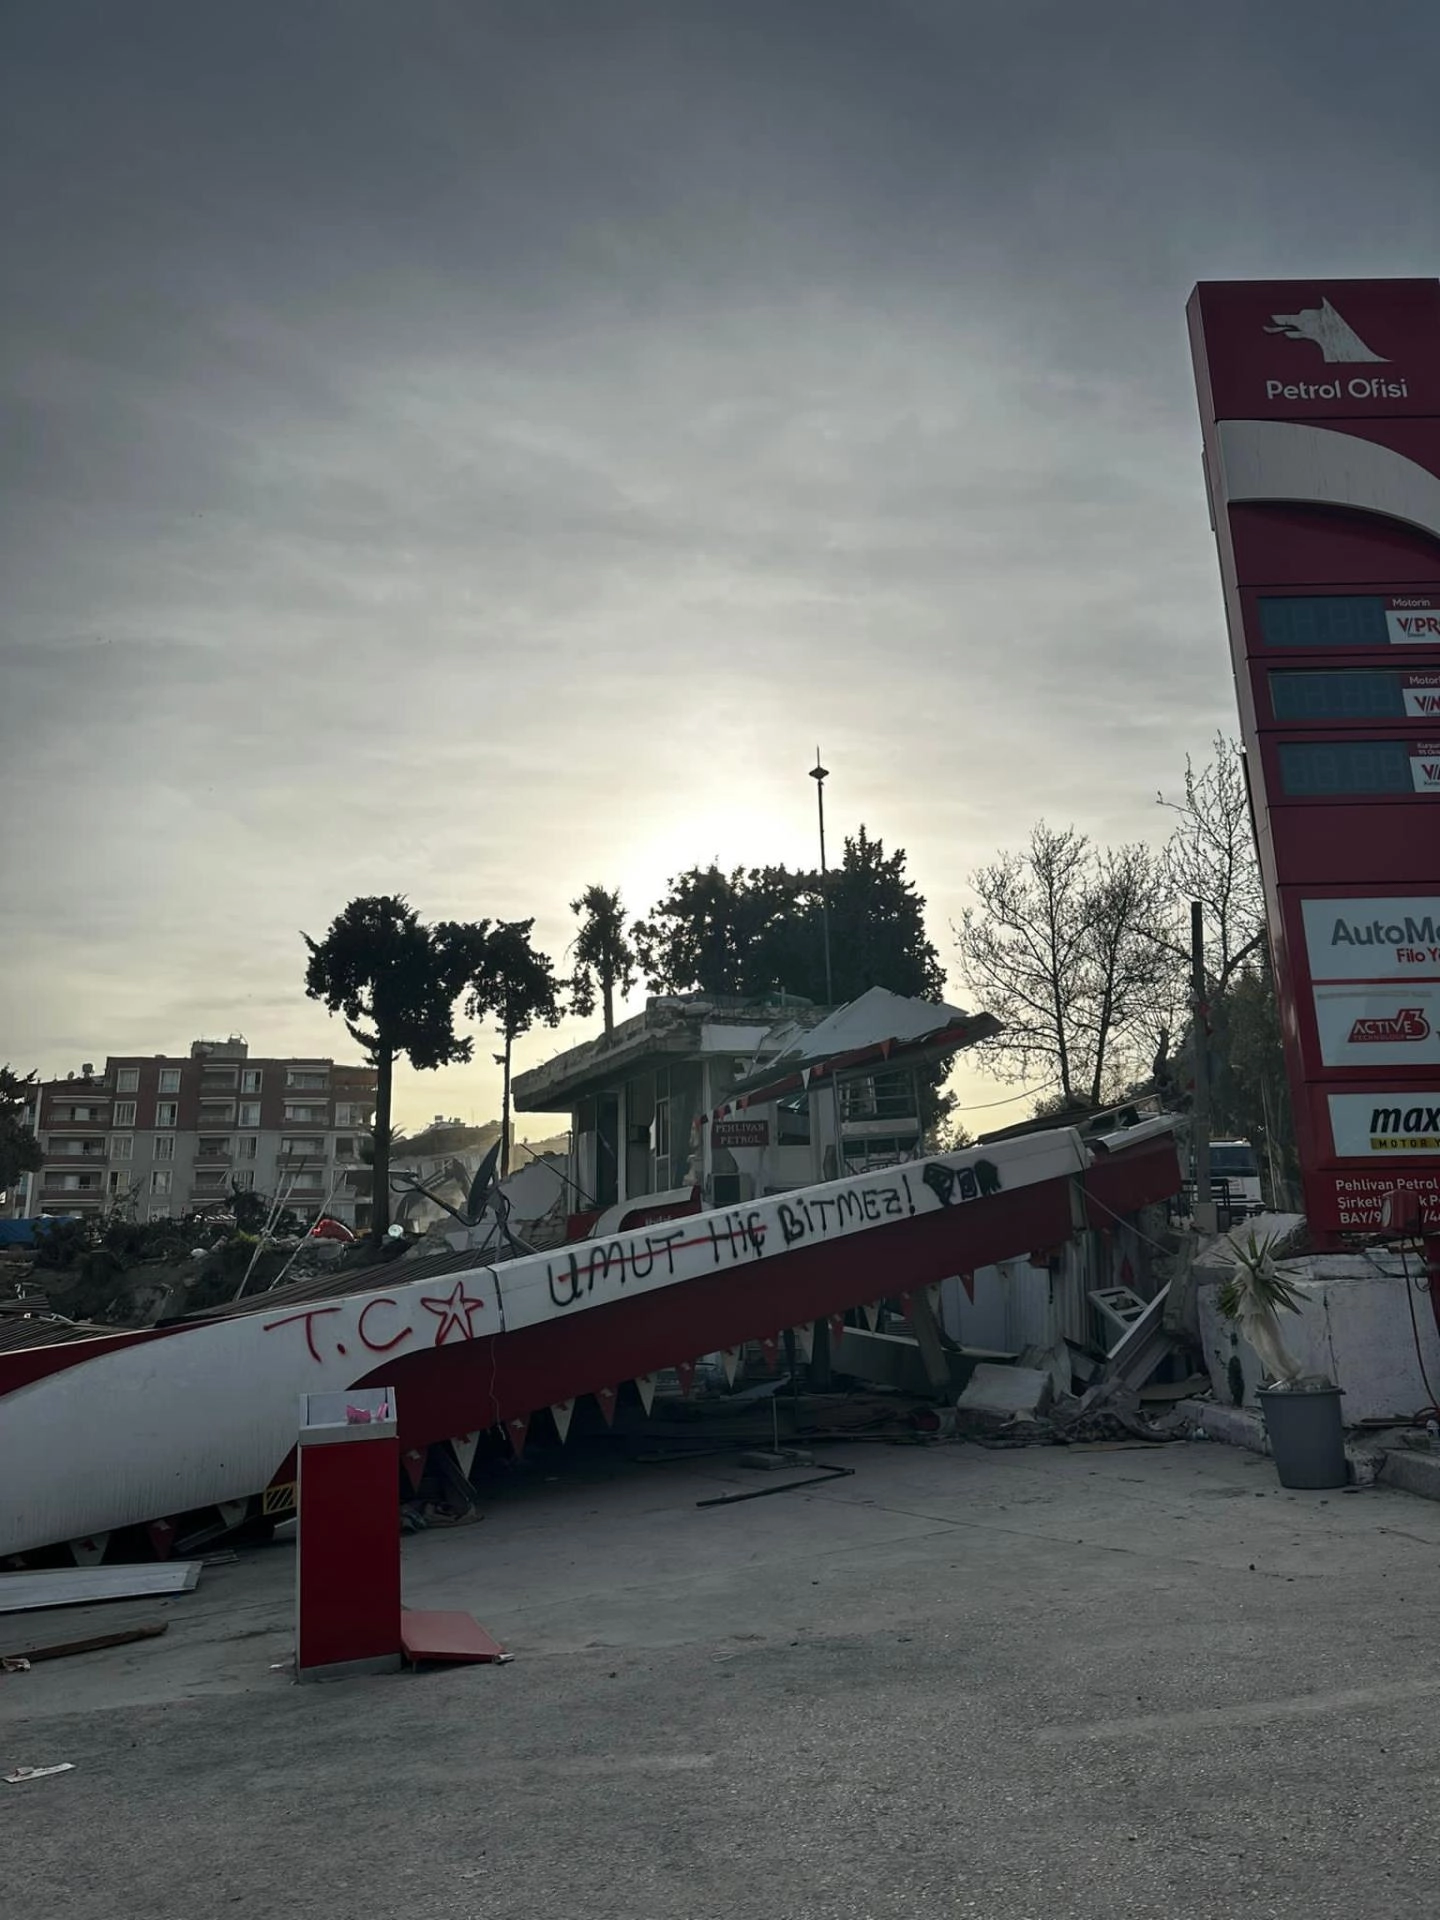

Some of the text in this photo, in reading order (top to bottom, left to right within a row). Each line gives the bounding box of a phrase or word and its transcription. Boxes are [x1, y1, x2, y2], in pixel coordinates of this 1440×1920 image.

[1266, 378, 1408, 399] Petrol Ofisi
[1392, 598, 1430, 607] Motorin
[1331, 917, 1440, 946] AutoM
[1396, 946, 1440, 963] Filo Y
[720, 1135, 760, 1144] PETROL
[1379, 1139, 1427, 1148] MOTOR
[1336, 1177, 1439, 1191] Pehlivan Petrol
[1338, 1196, 1382, 1209] Şirketi
[1429, 1194, 1440, 1206] P
[547, 1229, 685, 1307] UMUT
